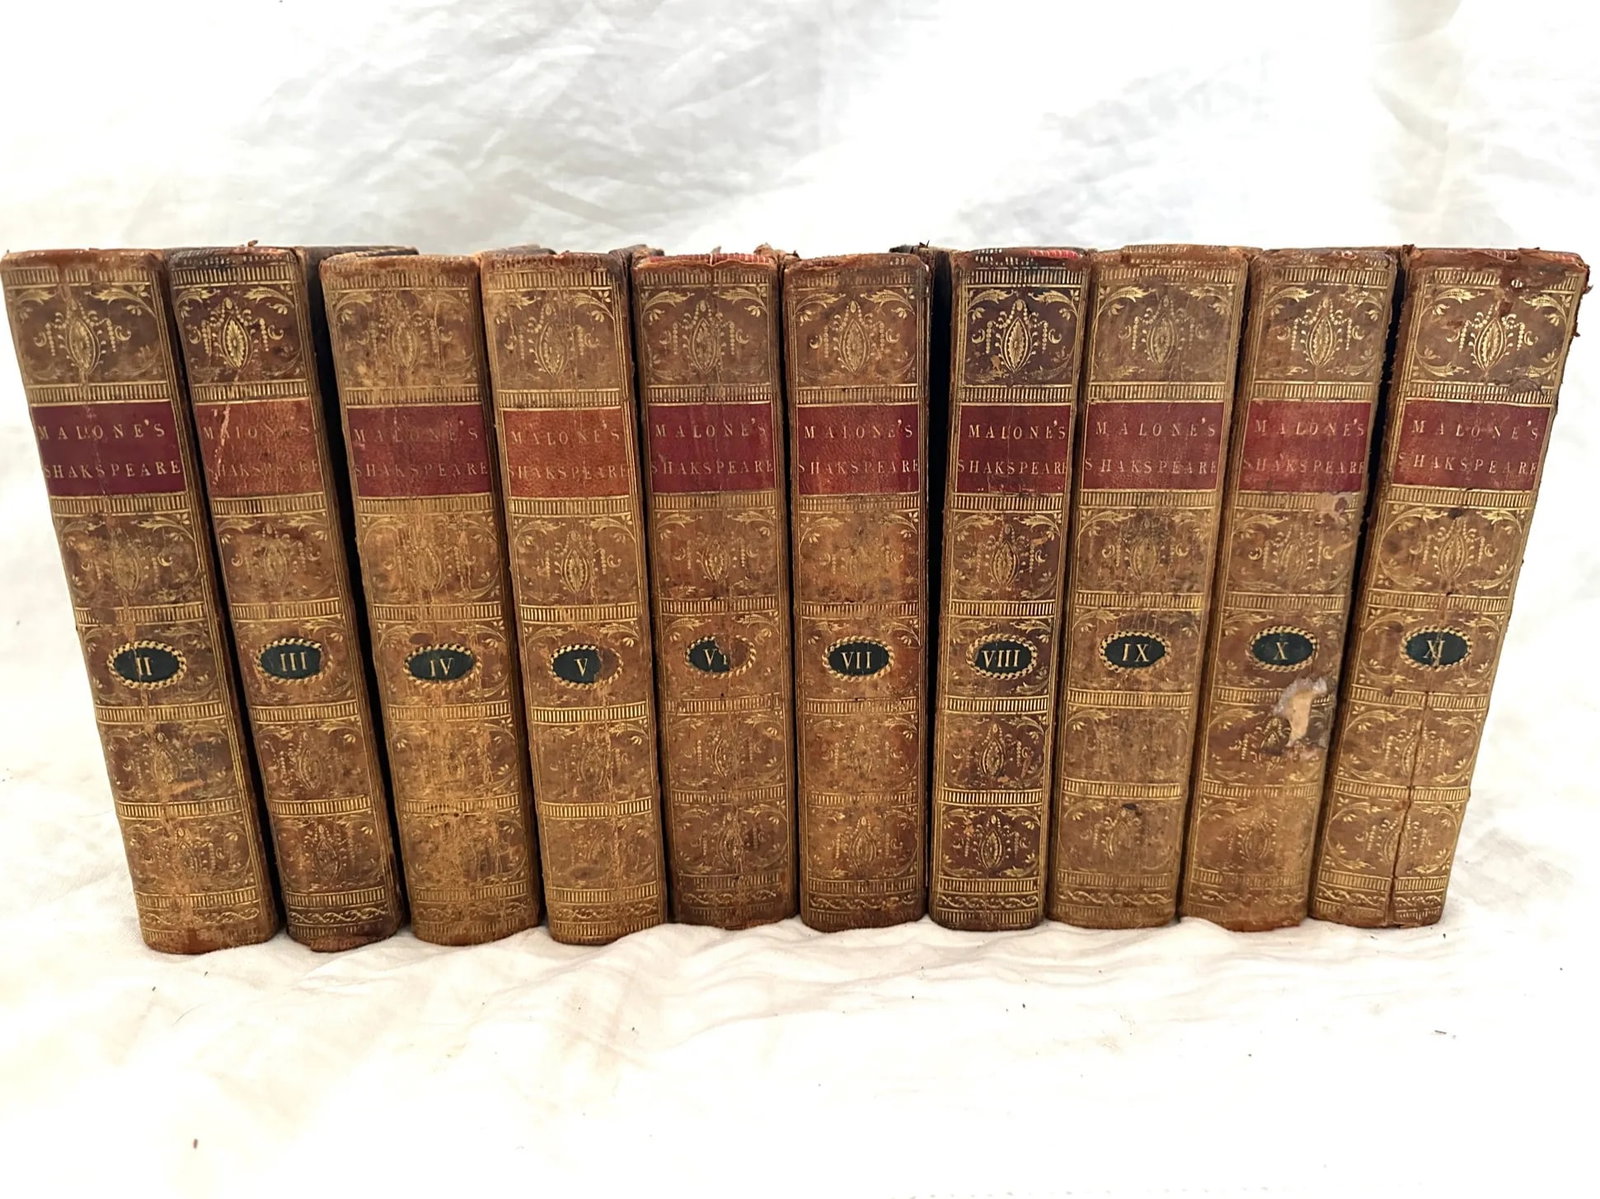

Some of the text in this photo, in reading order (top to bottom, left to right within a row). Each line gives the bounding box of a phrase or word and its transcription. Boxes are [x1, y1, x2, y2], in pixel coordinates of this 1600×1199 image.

[38, 419, 165, 440] MALONE'S
[655, 418, 766, 438] MALONE'S
[804, 419, 913, 439] MALONE'S
[968, 420, 1066, 439] MALONE'S
[1095, 417, 1216, 437] MALONE'S
[1254, 418, 1364, 436] MALONE'S
[43, 460, 181, 479] SHAKSPEARE
[651, 460, 774, 476] SHAKSPEARE
[1084, 458, 1217, 475] SHAKSPEARE
[841, 651, 872, 669] VII
[981, 650, 1020, 668] VIII
[1121, 643, 1149, 662] IX
[1273, 641, 1289, 660] X
[135, 656, 153, 676] II
[279, 651, 307, 672] III
[429, 657, 454, 677] IV
[574, 658, 589, 677] V
